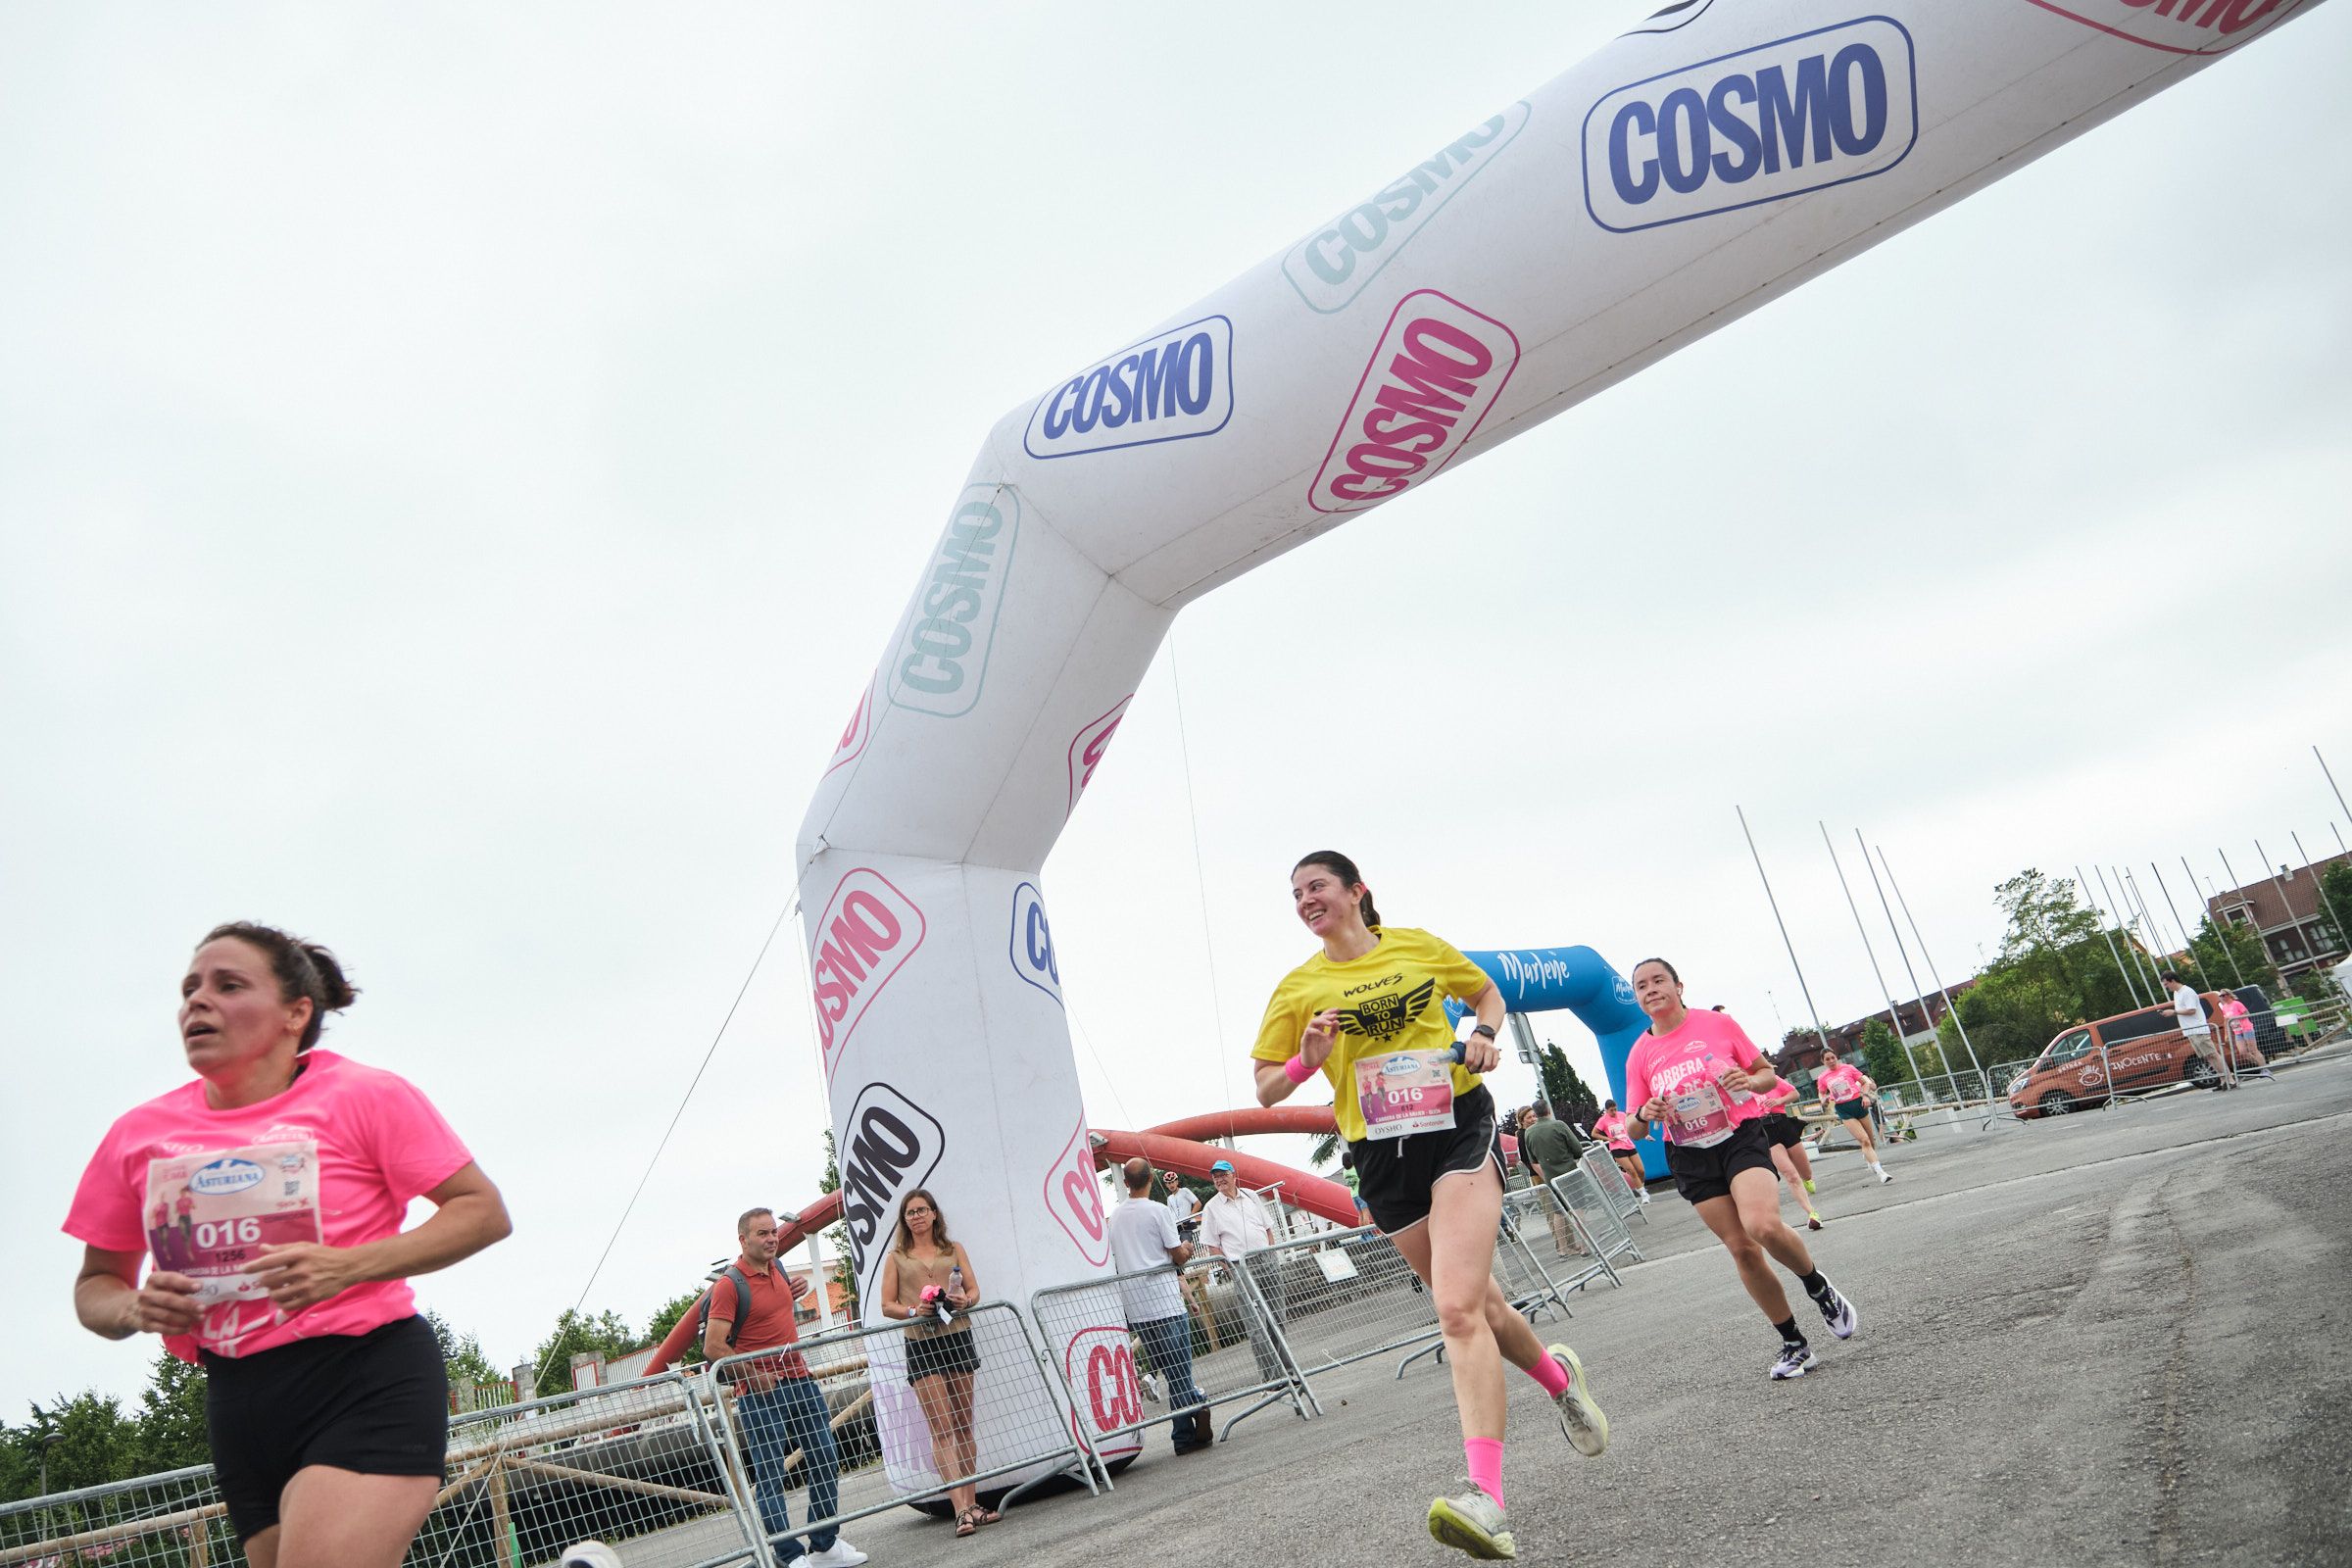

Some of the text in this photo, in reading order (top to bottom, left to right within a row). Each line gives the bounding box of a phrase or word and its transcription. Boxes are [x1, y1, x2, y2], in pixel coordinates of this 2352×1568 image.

[1609, 43, 1887, 205] COSMO
[1044, 332, 1213, 439] COSMO
[1331, 318, 1494, 501] COSMO
[901, 501, 1003, 694] COSMO
[1344, 972, 1403, 998] WOLVES
[1362, 996, 1397, 1015] BORN
[1374, 1010, 1391, 1021] TO
[1368, 1019, 1403, 1035] RUN
[1650, 1056, 1706, 1091] CARRERA
[1388, 1087, 1424, 1104] 016
[1375, 1124, 1402, 1134] OYSHO
[1685, 1116, 1708, 1131] 016
[197, 1172, 260, 1189] ASTURIANA
[196, 1217, 262, 1249] 016
[216, 1250, 246, 1262] 1256
